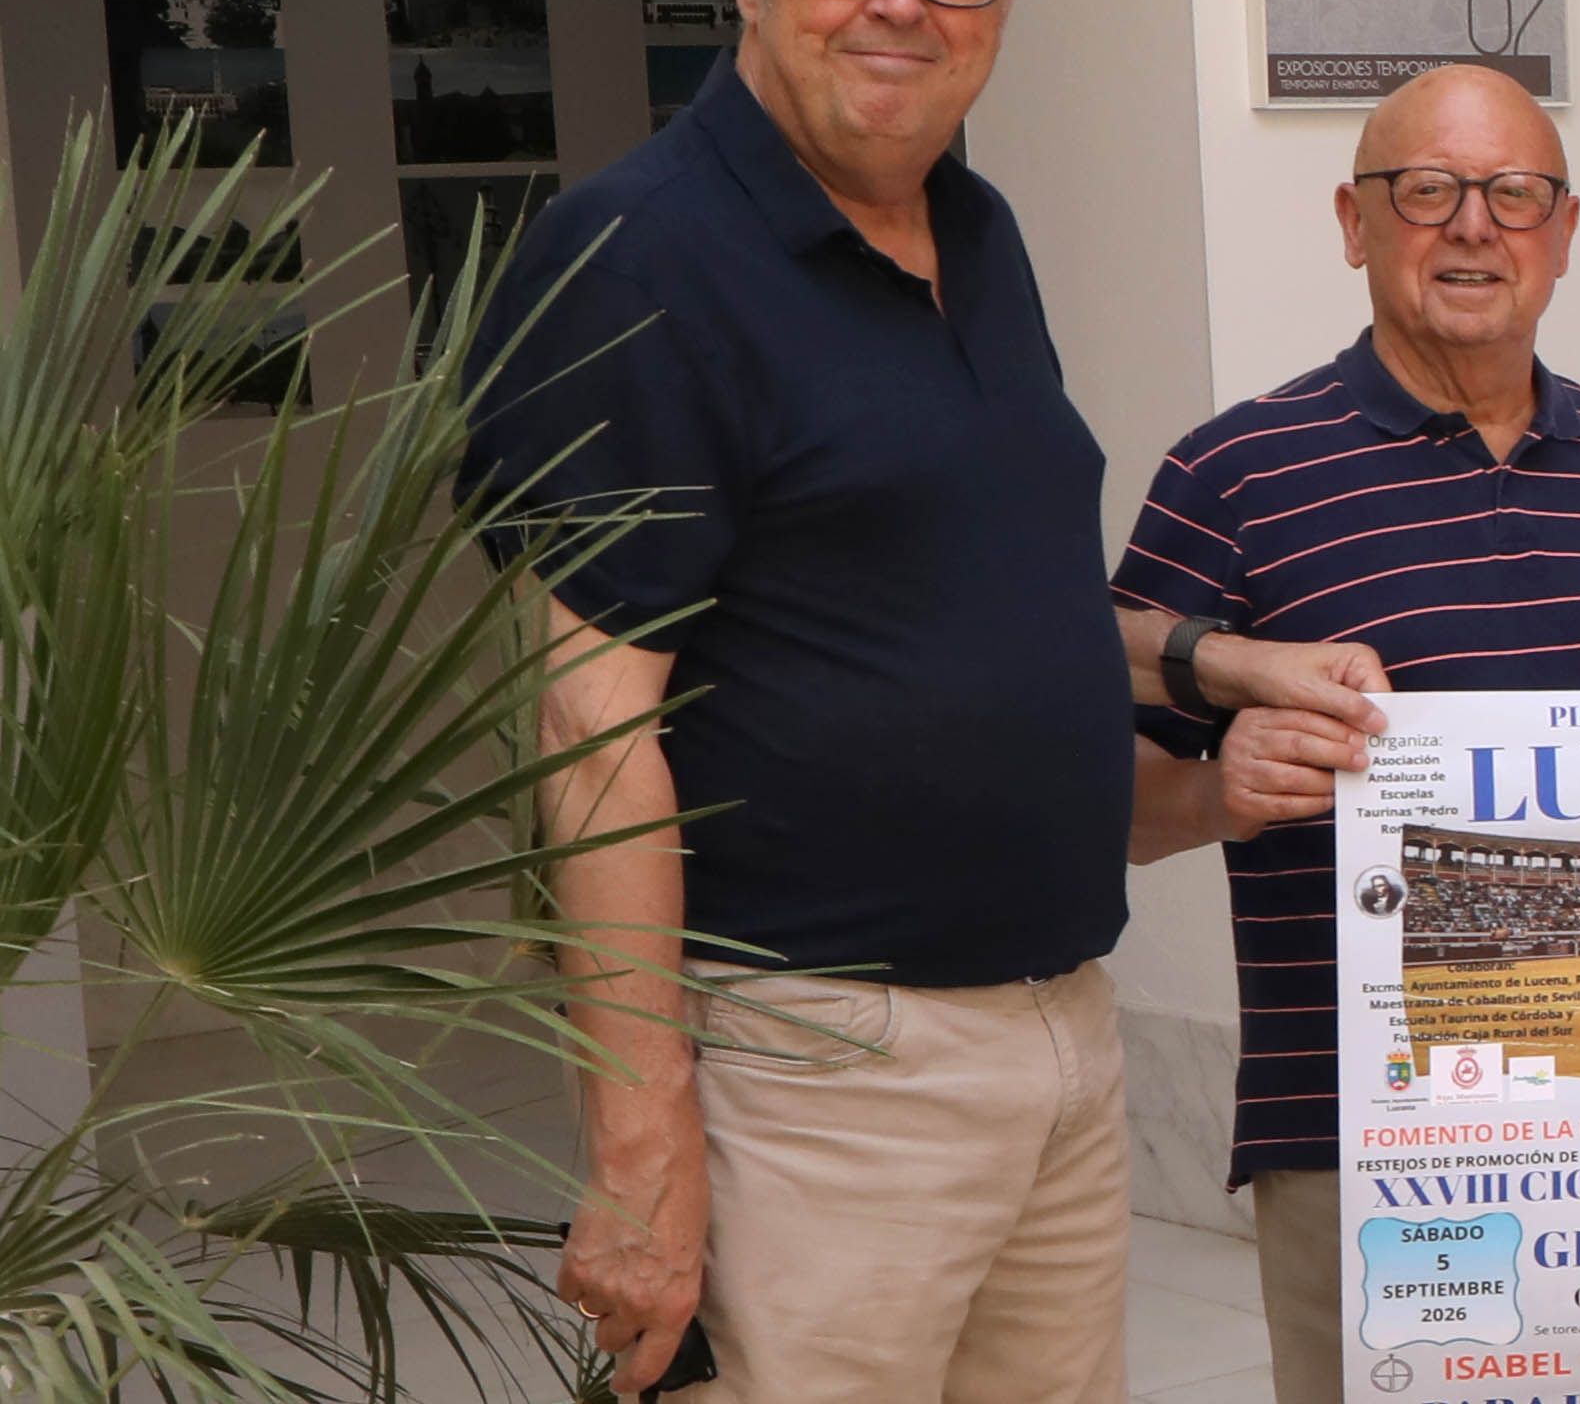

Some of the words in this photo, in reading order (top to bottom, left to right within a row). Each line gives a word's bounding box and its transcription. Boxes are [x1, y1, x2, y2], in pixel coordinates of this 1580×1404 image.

[1277, 60, 1373, 76] EXPOSICIONES
[1280, 79, 1330, 90] TEMPORARY
[1364, 1124, 1493, 1148] FOMENTO
[1500, 1119, 1535, 1143] DE
[1543, 1120, 1574, 1139] LA
[1402, 1223, 1484, 1243] SÁBADO
[1437, 1254, 1450, 1271] 5
[1383, 1280, 1504, 1299] SEPTIEMBRE
[1421, 1307, 1467, 1322] 2026
